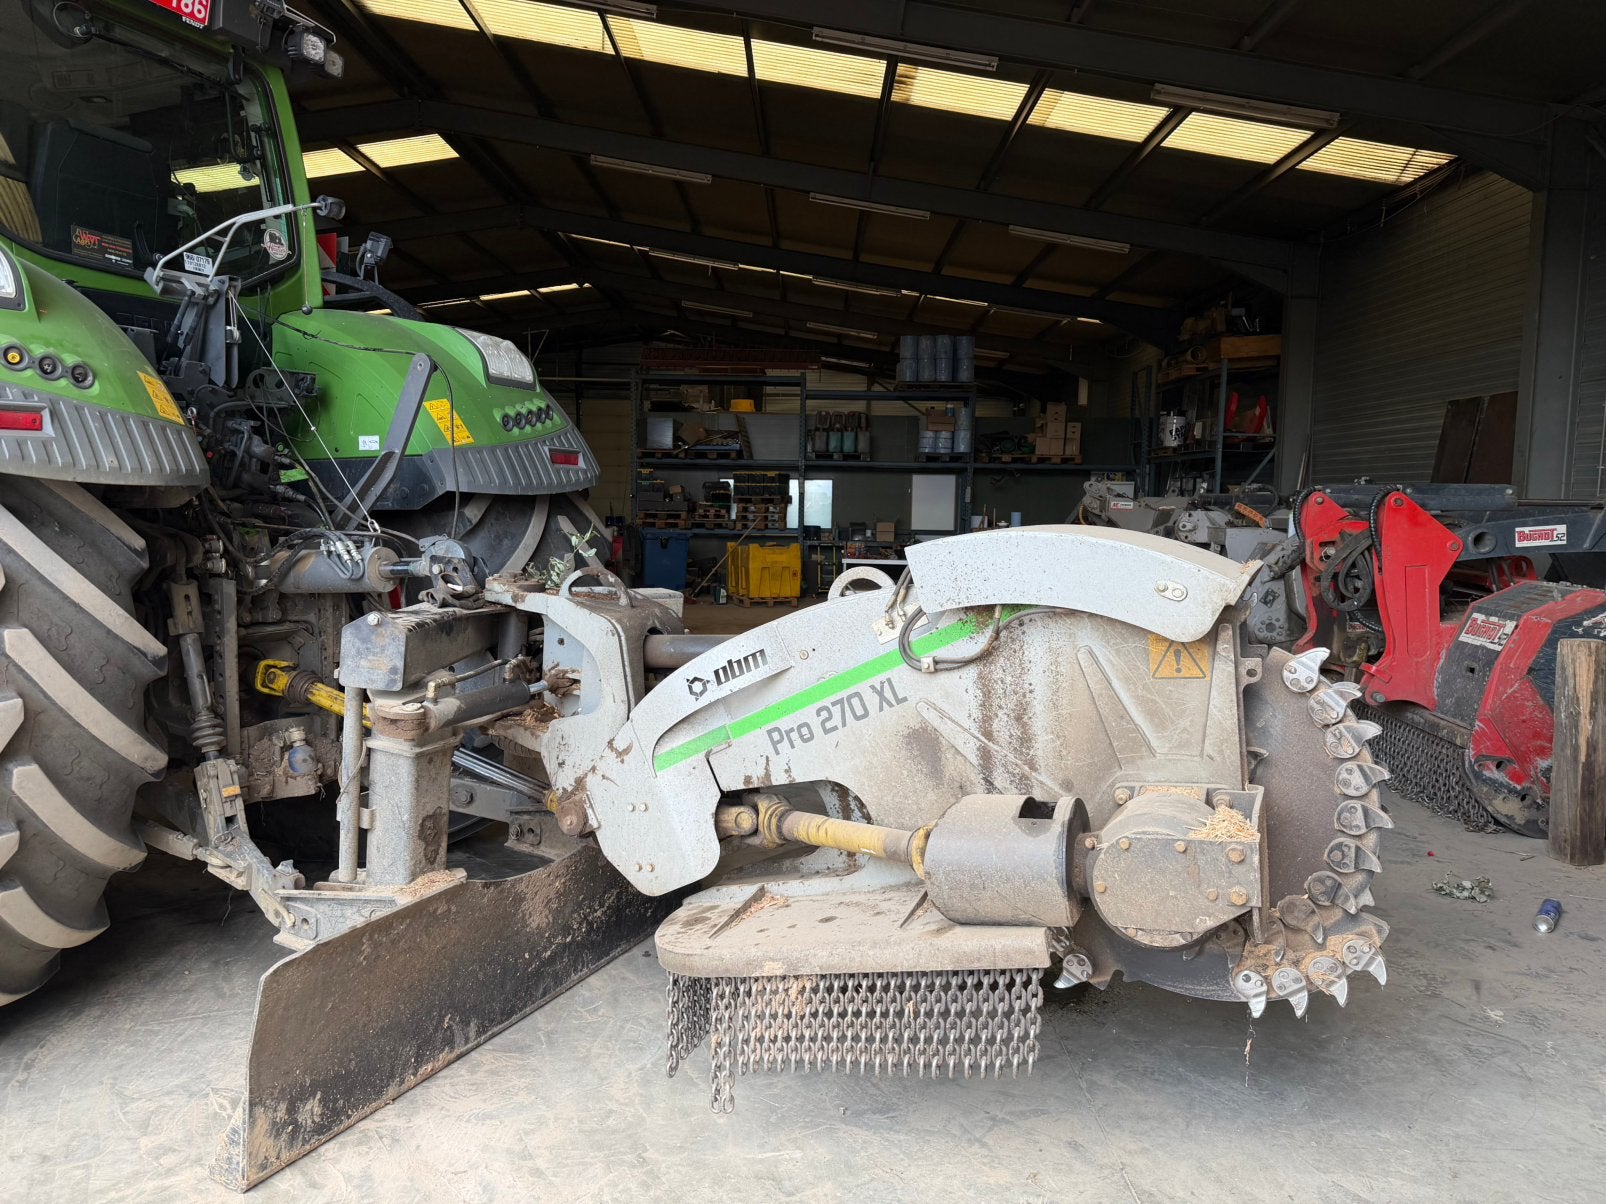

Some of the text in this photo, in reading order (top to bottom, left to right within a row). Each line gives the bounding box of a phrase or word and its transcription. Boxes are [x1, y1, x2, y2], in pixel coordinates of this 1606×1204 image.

[765, 676, 909, 757] Pro 270 XL
